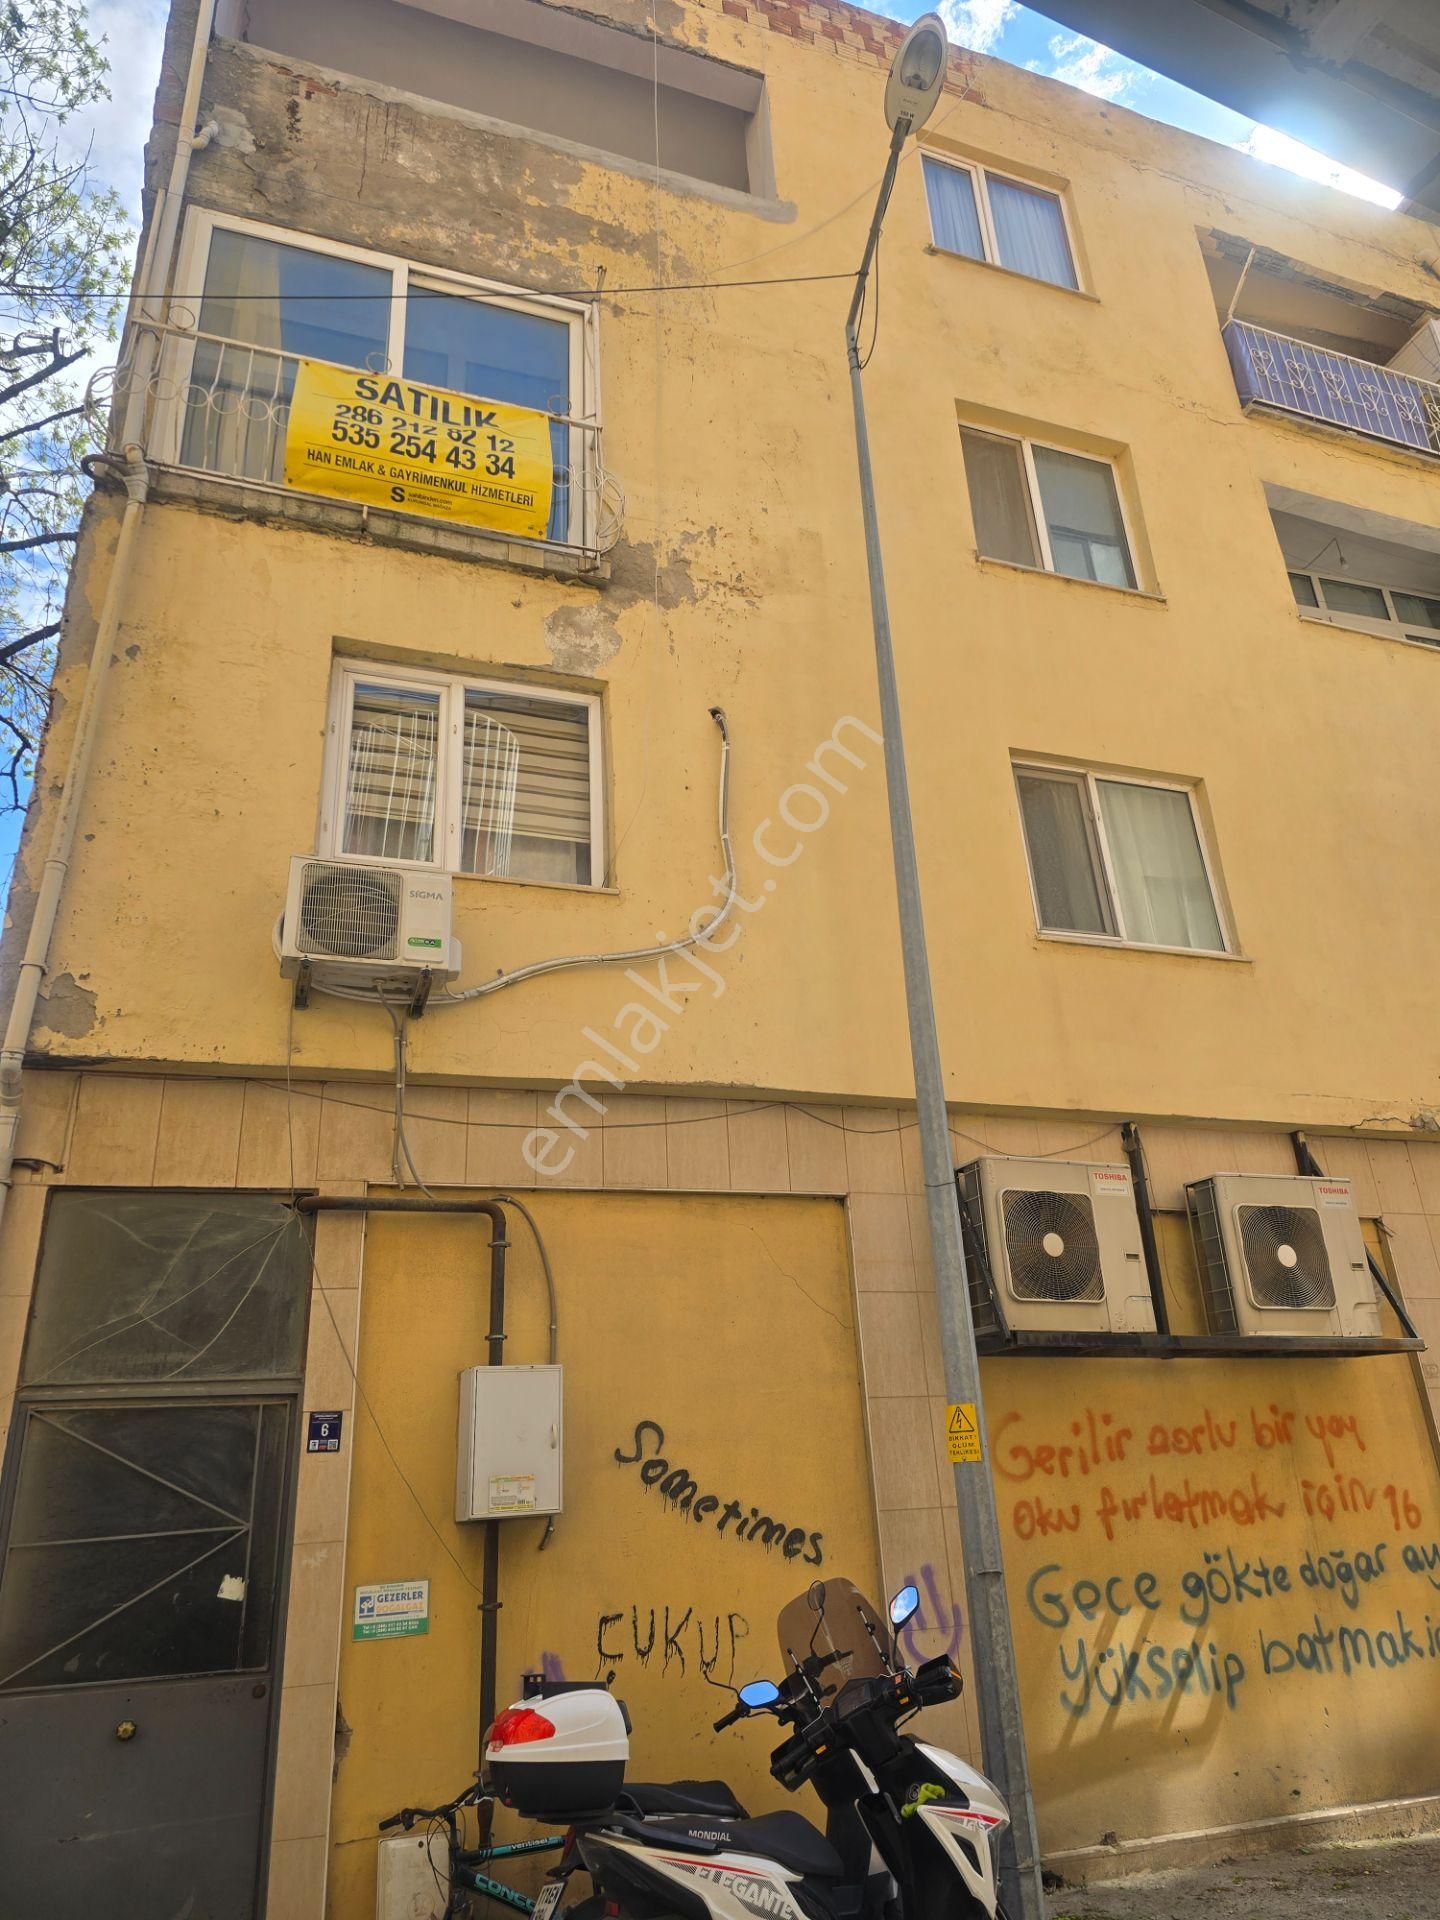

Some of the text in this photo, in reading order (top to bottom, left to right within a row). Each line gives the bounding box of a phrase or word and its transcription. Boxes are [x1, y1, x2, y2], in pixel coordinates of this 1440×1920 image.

[355, 377, 500, 429] SATILIK
[331, 420, 515, 479] 535 254 43 34
[335, 404, 383, 426] 286
[392, 417, 438, 436] 212
[487, 434, 515, 453] 12
[307, 448, 535, 508] HAN EMLAK & GAYRİMENKUL HİZMETLERİ
[409, 890, 444, 901] SIGMA
[1093, 1172, 1127, 1181] TOSHIBA
[1318, 1187, 1349, 1195] TOSHIBA
[321, 1423, 329, 1437] 6
[1250, 1403, 1296, 1451] bir
[614, 1420, 824, 1567] Sometimes
[377, 1591, 424, 1603] GEZERLER
[1027, 1564, 1161, 1630] Gece
[1180, 1546, 1293, 1628] gökte
[1299, 1542, 1388, 1611] doğar
[688, 1829, 732, 1842] MONDIAL
[697, 1863, 797, 1920] ELEGANTE
